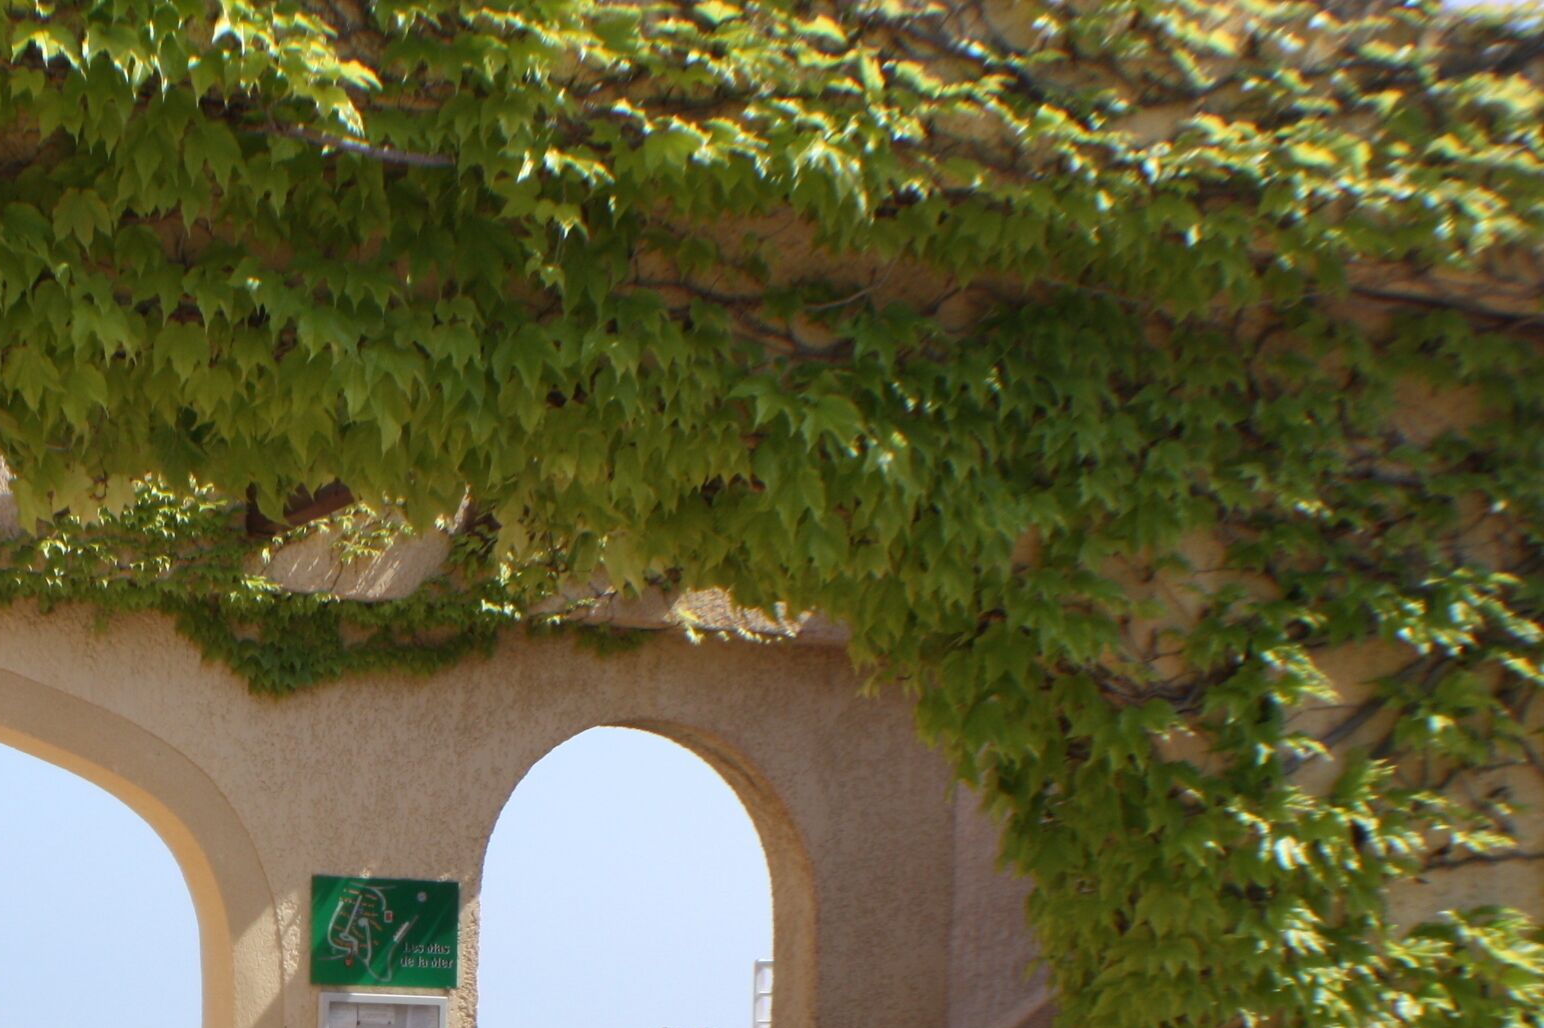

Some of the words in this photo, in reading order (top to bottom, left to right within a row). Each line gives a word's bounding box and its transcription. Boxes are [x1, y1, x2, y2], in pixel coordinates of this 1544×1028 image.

[400, 956, 415, 968] de
[418, 956, 429, 968] la
[430, 957, 454, 969] Mer
